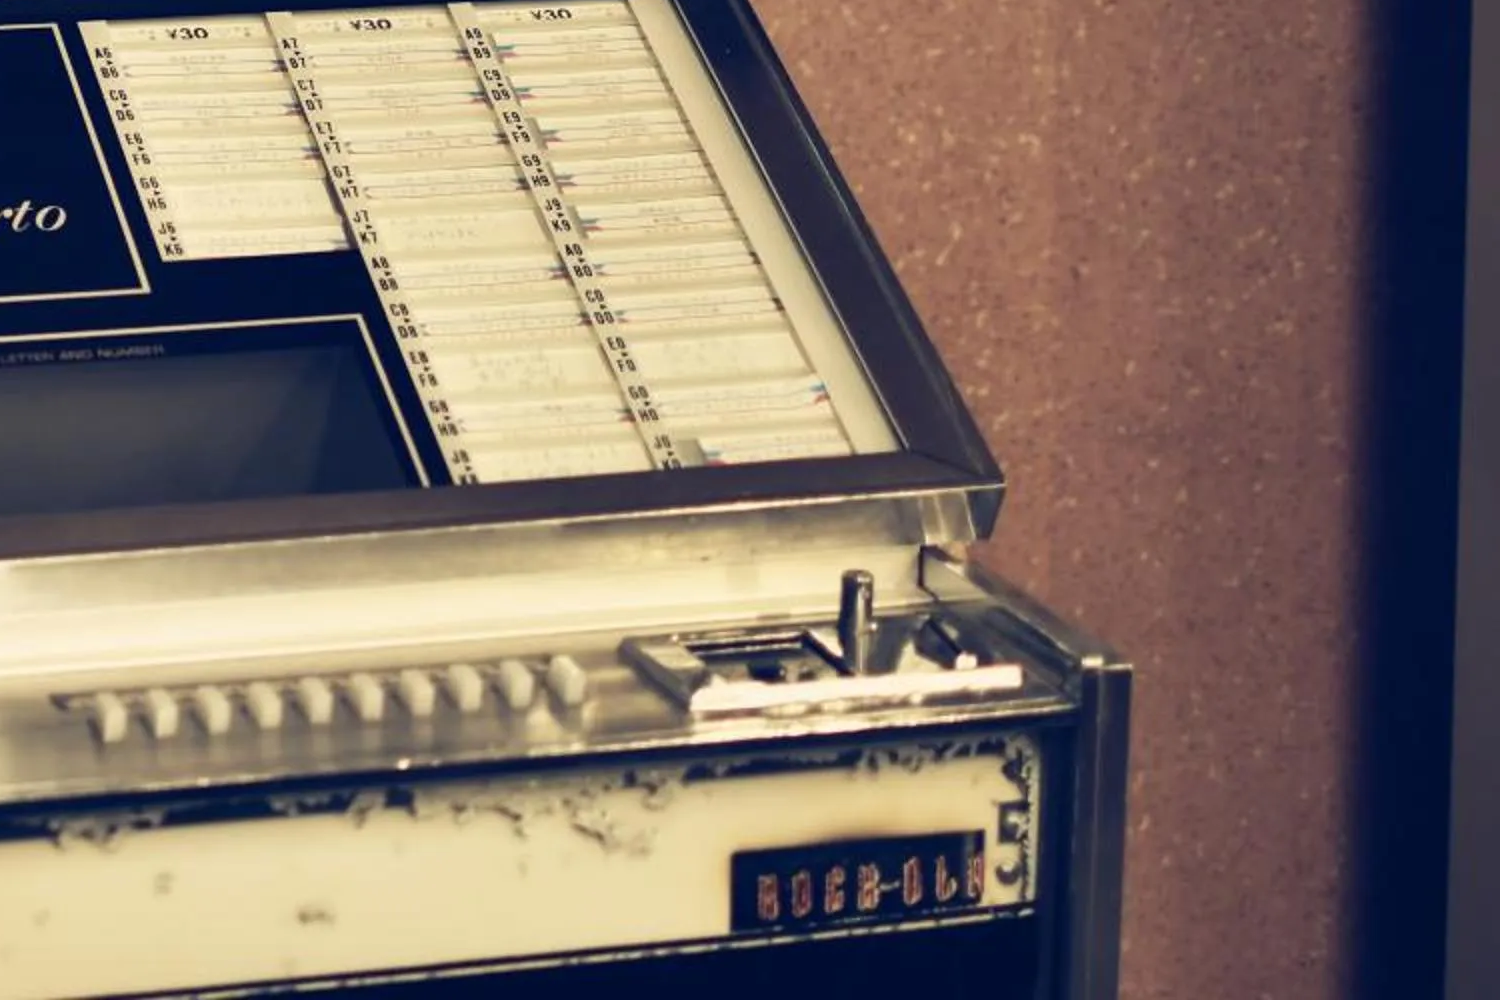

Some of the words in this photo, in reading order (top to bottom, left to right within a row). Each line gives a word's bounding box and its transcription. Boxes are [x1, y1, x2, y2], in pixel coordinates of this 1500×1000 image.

[465, 28, 482, 40] A9
[283, 38, 299, 48] A7
[96, 48, 112, 59] A6
[474, 47, 490, 59] B9
[290, 58, 306, 68] B7
[102, 67, 118, 79] B6
[483, 70, 501, 81] C9
[298, 79, 314, 90] C7
[110, 90, 127, 101] C6
[492, 90, 510, 101] D9
[306, 100, 323, 110] D7
[115, 109, 134, 121] D6
[503, 112, 520, 124] E9
[316, 121, 332, 134] E7
[125, 133, 142, 145] E6
[512, 131, 530, 142] F9
[323, 142, 341, 153] F7
[133, 154, 151, 165] F6
[522, 154, 540, 167] G9
[333, 165, 350, 178] G7
[140, 177, 159, 189] G6
[532, 175, 550, 186] H9
[341, 186, 359, 198] H7
[147, 198, 166, 209] H6
[545, 198, 561, 211] J9
[353, 209, 369, 222] J7
[159, 222, 175, 234] J6
[552, 219, 570, 231] K9
[360, 232, 377, 243] K7
[163, 244, 182, 255] K6
